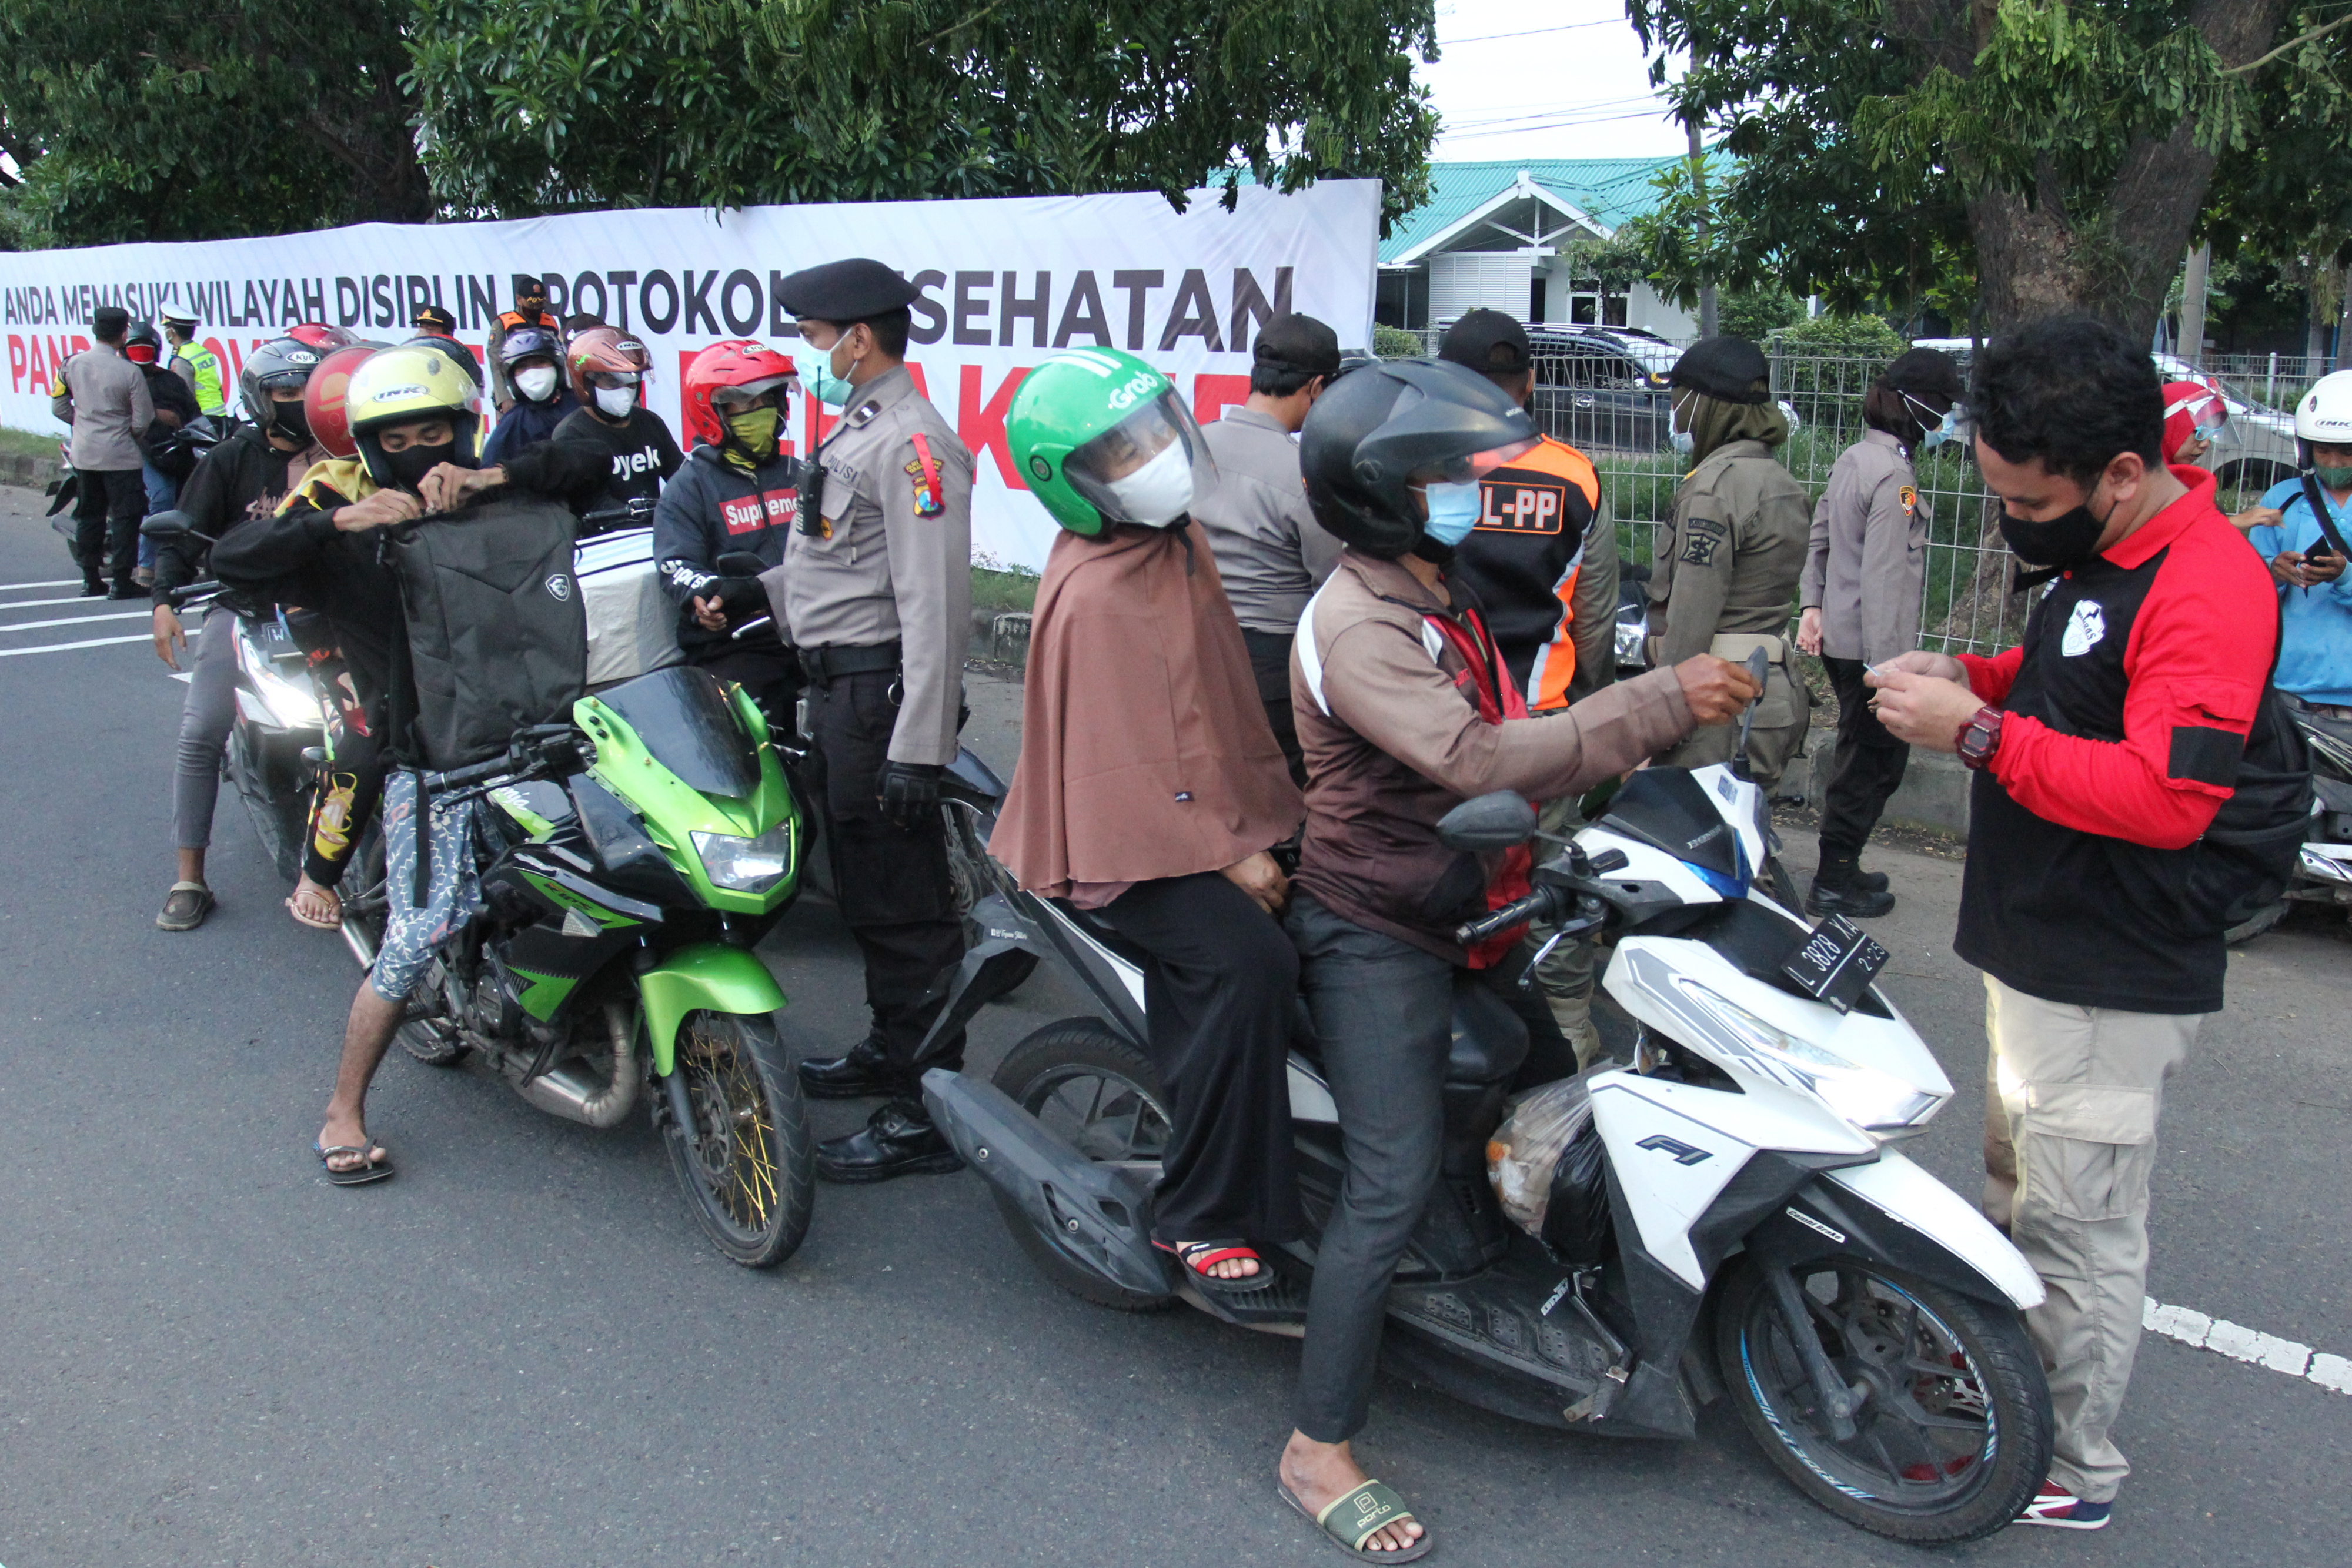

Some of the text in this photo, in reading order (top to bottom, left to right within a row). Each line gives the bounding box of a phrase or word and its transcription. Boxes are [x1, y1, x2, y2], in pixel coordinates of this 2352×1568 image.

[6, 286, 59, 325] ANDA
[186, 278, 326, 327] WILAYAH
[896, 266, 1294, 353] SEHATAN
[378, 386, 422, 399] INK
[1110, 370, 1158, 409] Grab
[826, 454, 858, 482] POLISI
[1479, 486, 1557, 529] L-PP
[1788, 913, 1860, 986] L 3828 XA
[1788, 1209, 1842, 1241] Combi Brake
[1772, 1424, 1843, 1486] RIDE IT
[1357, 1504, 1391, 1529] porto
[1359, 1496, 1371, 1509] P
